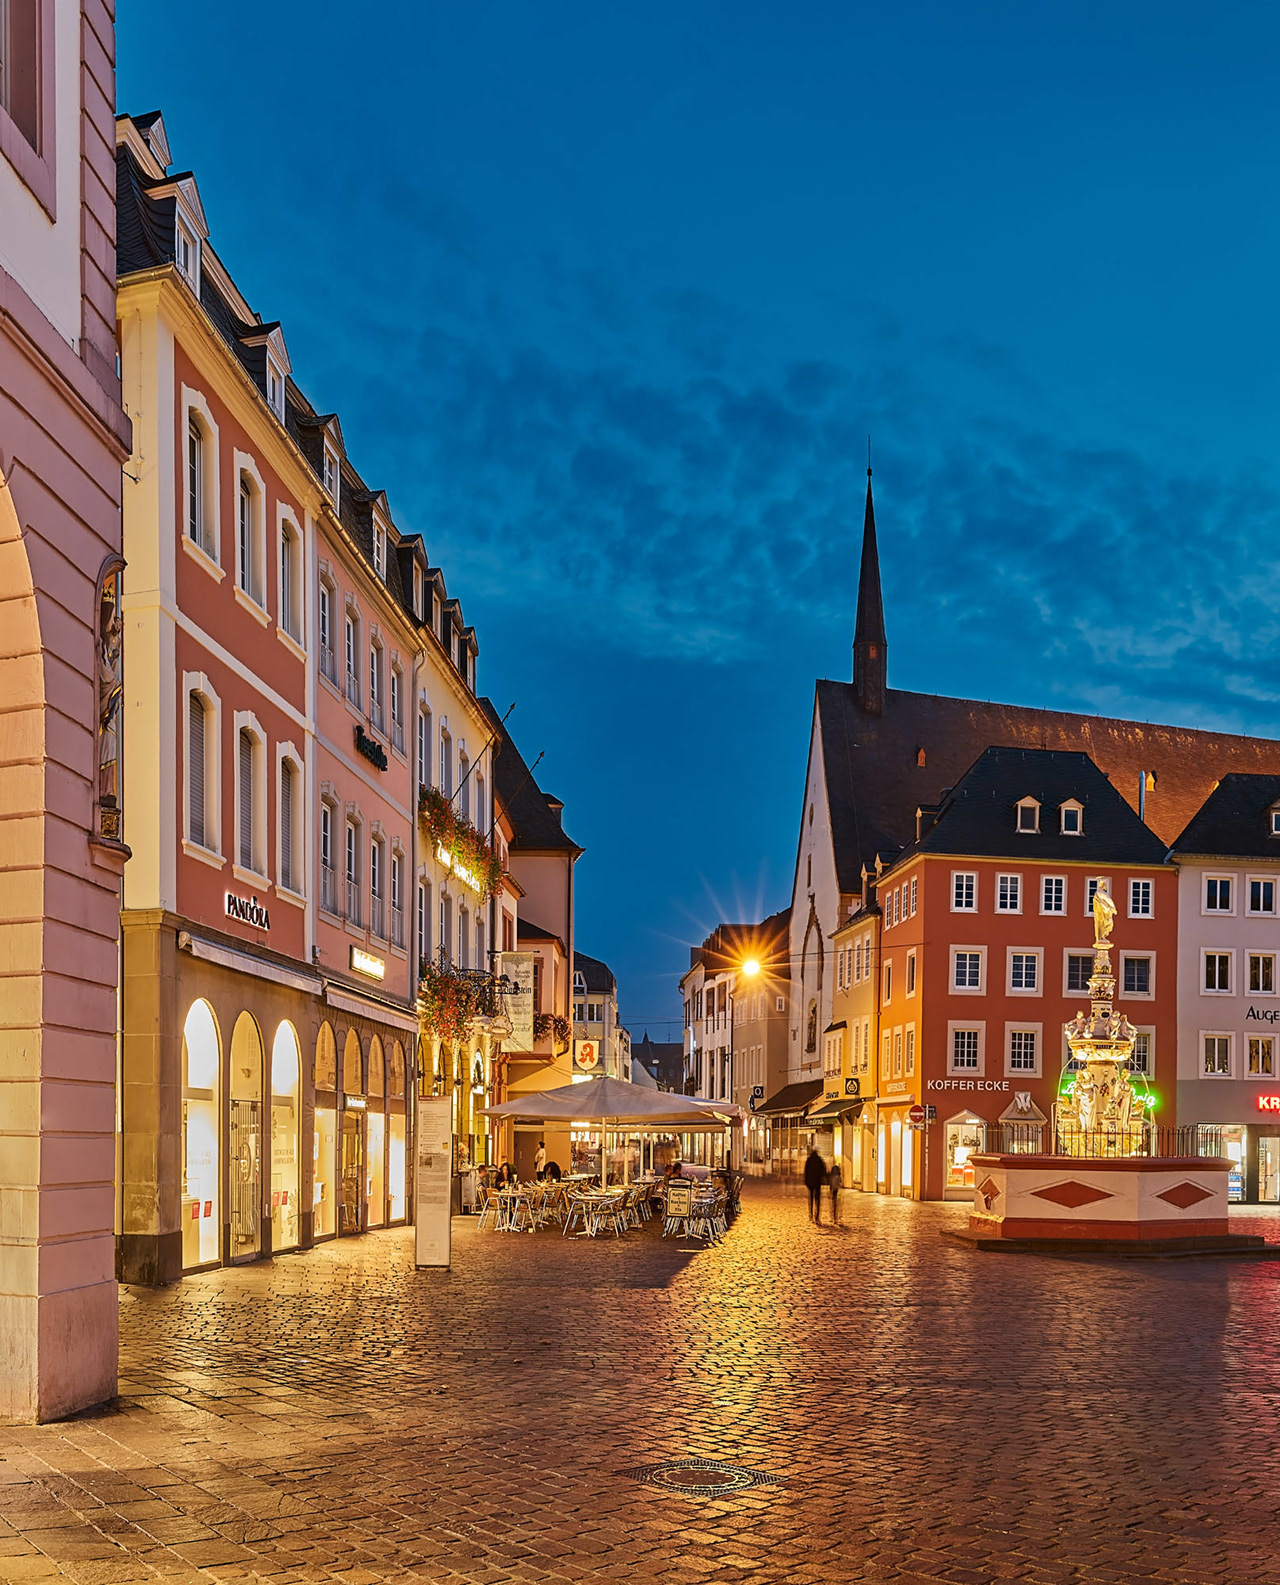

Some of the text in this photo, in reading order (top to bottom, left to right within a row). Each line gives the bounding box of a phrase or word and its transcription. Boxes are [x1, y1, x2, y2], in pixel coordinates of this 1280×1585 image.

[227, 894, 270, 930] PANDORA
[927, 1079, 1010, 1091] KOFFER ECKE
